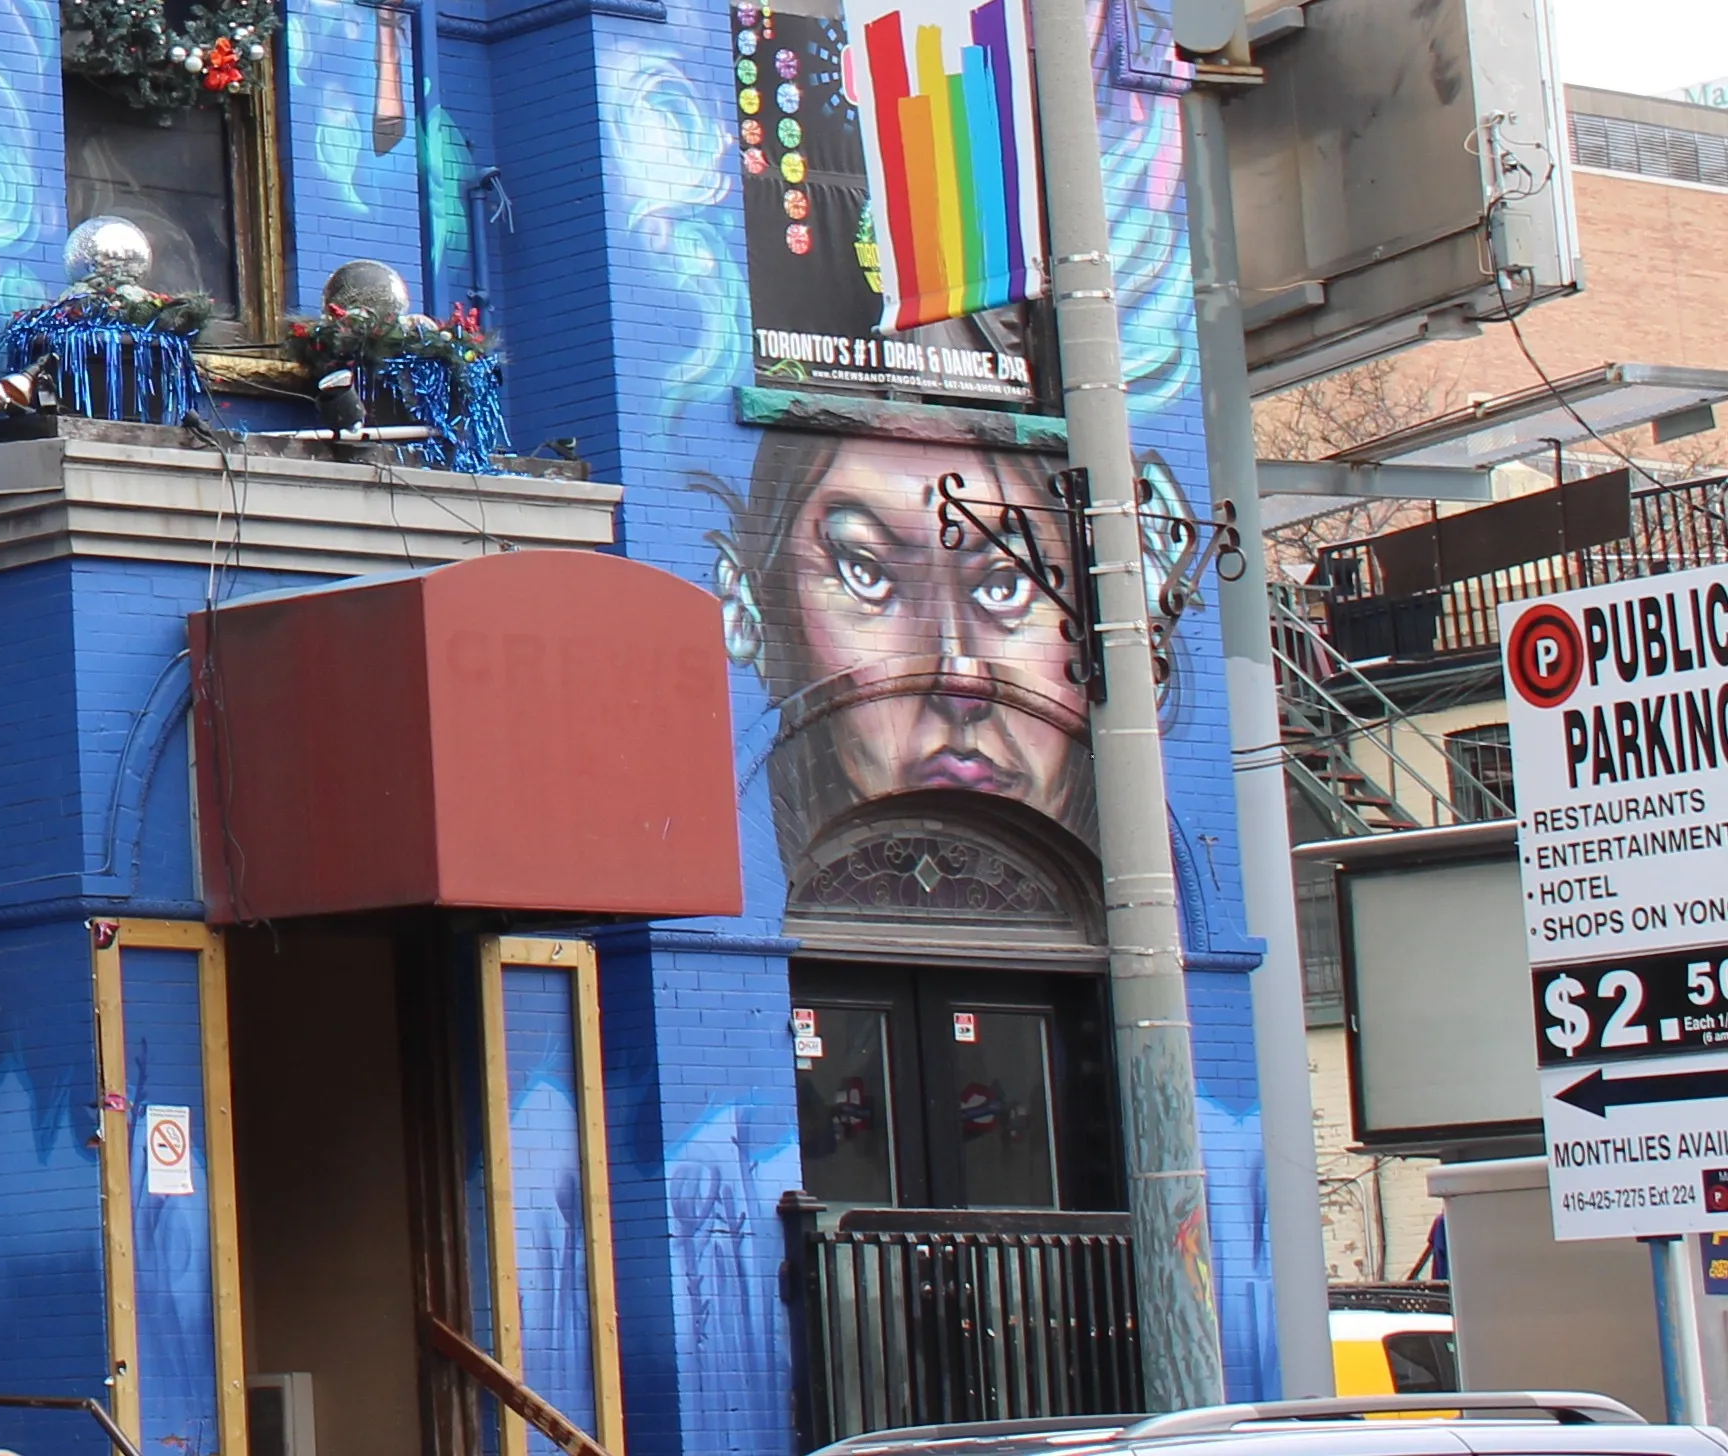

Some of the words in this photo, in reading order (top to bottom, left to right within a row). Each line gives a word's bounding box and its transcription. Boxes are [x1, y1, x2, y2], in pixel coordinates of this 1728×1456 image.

[756, 328, 850, 364] TORONTO'S
[853, 338, 878, 368] #1
[927, 346, 941, 373] &
[941, 347, 993, 379] DANCE
[997, 352, 1030, 383] BAR
[1583, 581, 1728, 687] PUBLIC
[1533, 788, 1706, 834] RESTAURANTS
[1540, 875, 1618, 906] HOTEL
[1543, 909, 1624, 941] SHOPS
[1632, 905, 1668, 930] ON
[1674, 898, 1728, 926] YON
[1684, 1014, 1715, 1031] Each
[1553, 1133, 1671, 1168] MONTHLIES
[1562, 1188, 1645, 1212] 416-425-7275
[1649, 1186, 1670, 1206] Ext
[1672, 1184, 1695, 1205] 224
